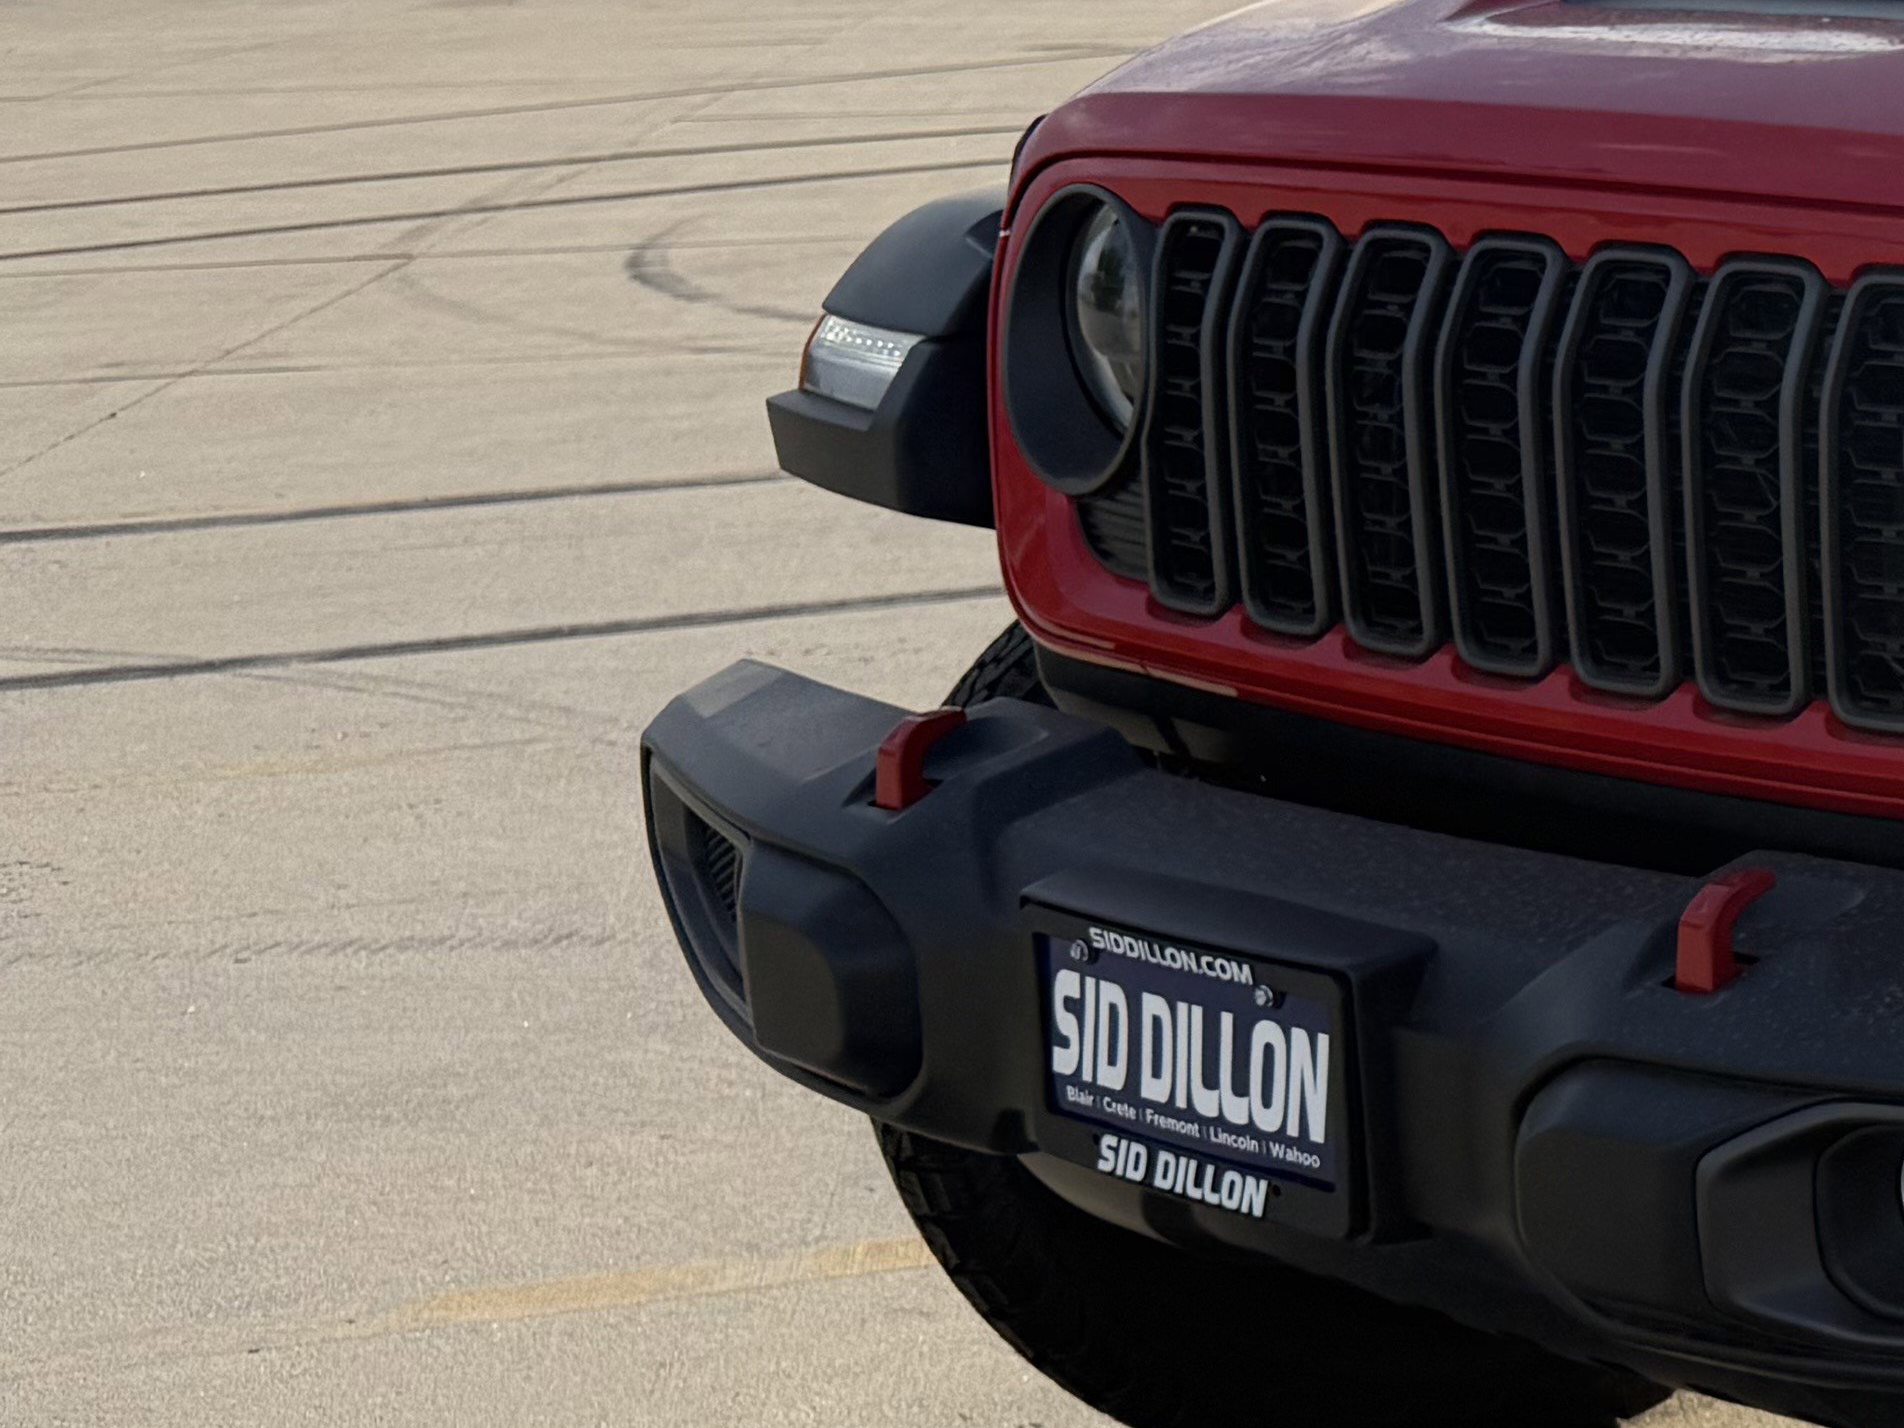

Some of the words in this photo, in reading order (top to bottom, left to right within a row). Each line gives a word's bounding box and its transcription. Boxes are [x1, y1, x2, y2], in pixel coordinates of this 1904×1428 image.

[1089, 926, 1254, 986] SIDDILLON.COM
[1052, 969, 1129, 1091] SID
[1141, 992, 1330, 1144] DILLON
[1066, 1084, 1095, 1107] Blair
[1103, 1096, 1137, 1121] Crete
[1145, 1108, 1200, 1138] Fremont
[1210, 1125, 1259, 1154] Lincoln
[1269, 1141, 1321, 1169] Wahoo
[1097, 1133, 1148, 1183] SID
[1154, 1149, 1269, 1219] DILLON
